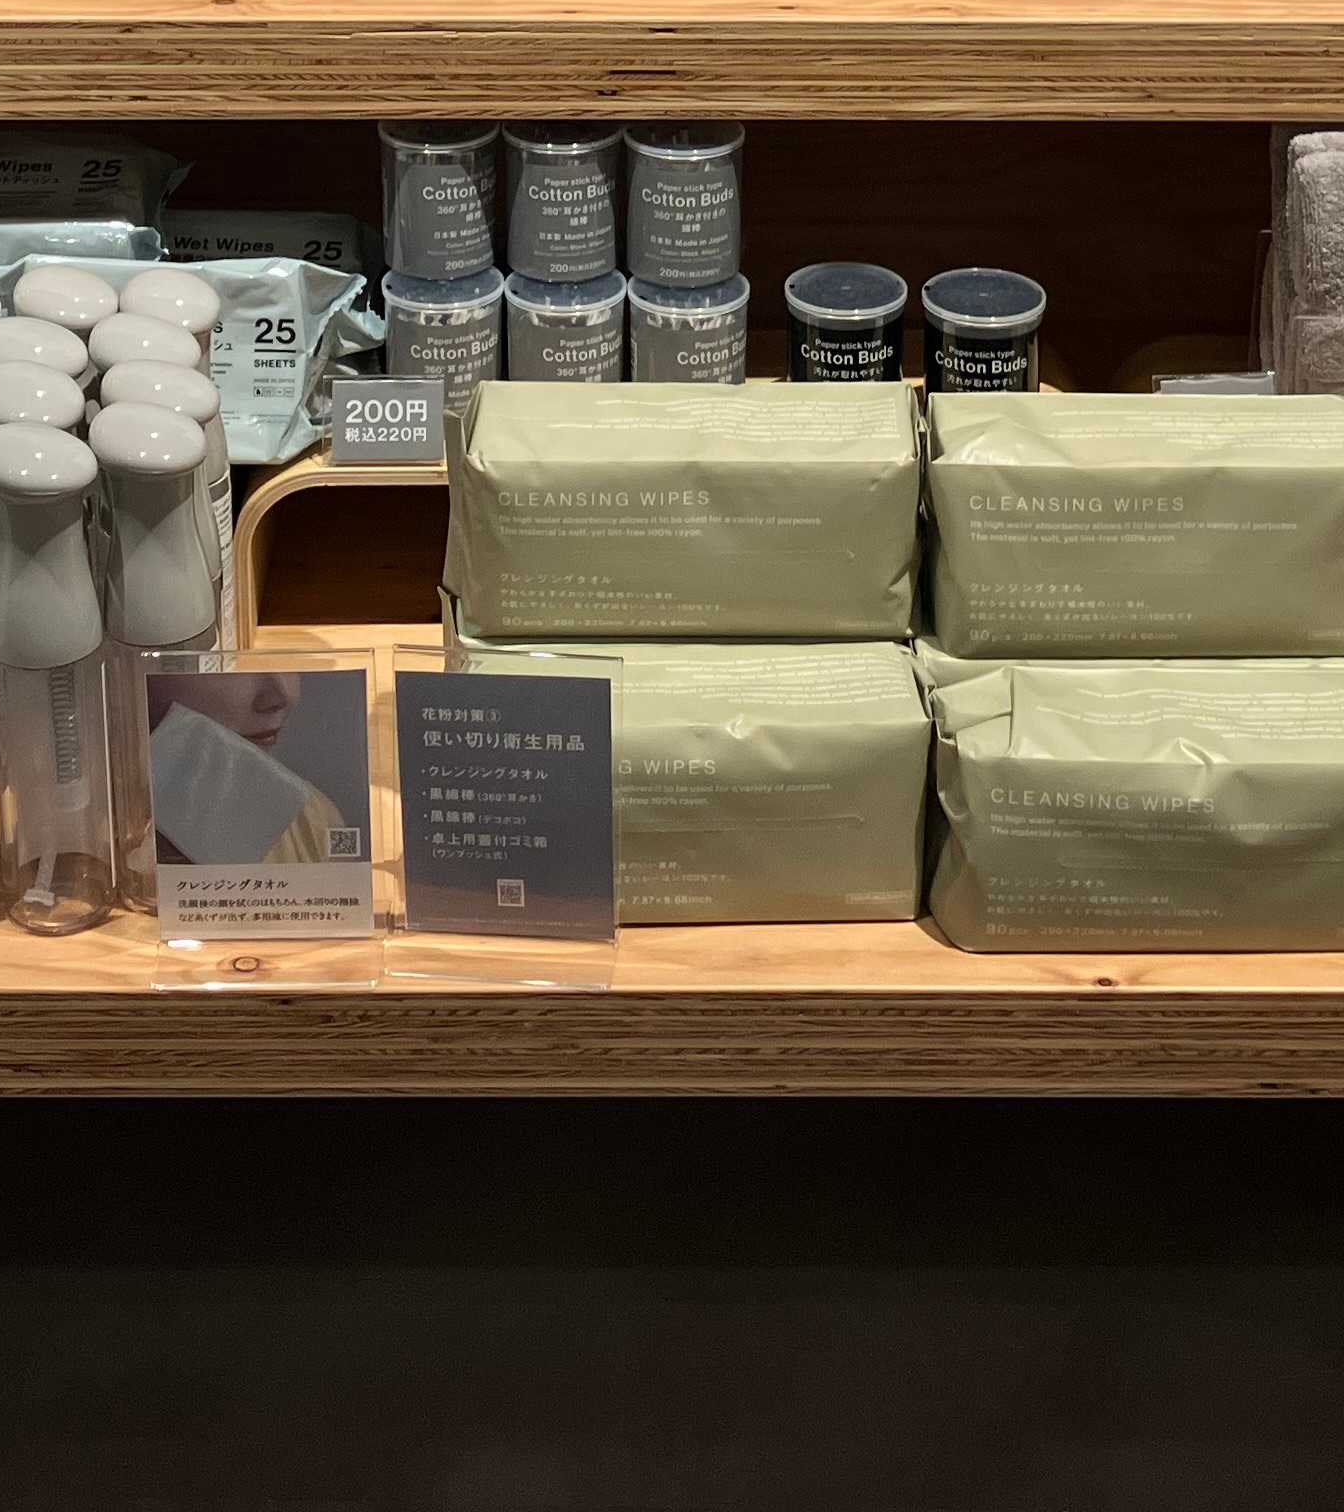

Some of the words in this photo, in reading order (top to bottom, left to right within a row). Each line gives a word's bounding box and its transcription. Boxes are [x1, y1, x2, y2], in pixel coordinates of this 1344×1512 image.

[81, 159, 123, 178] 25
[422, 186, 478, 201] Cotton
[529, 185, 583, 202] Cotton
[642, 189, 697, 208] Cotton
[700, 188, 735, 207] Buds
[174, 236, 209, 250] Wet
[215, 237, 274, 253] Wipes
[304, 240, 344, 261] 25
[255, 318, 296, 345] 25
[410, 344, 467, 361] Cotton
[863, 339, 882, 350] type
[542, 347, 597, 364] Cotton
[677, 349, 729, 366] Cotton
[800, 344, 854, 366] Cotton
[858, 343, 894, 365] Buds
[935, 351, 986, 374] Cotton
[991, 356, 1028, 375] Buds
[254, 359, 296, 368] SHEETS
[345, 400, 428, 424] 200円
[345, 427, 428, 443] 税込220円
[498, 491, 630, 507] CLEANSING
[639, 490, 711, 506] WIPES
[969, 495, 1103, 513] CLEANSING
[1113, 497, 1185, 513] WIPES
[423, 731, 585, 752] 使い切り衛生用品
[643, 759, 717, 775] WIPES
[990, 788, 1130, 811] CLEANSING
[1141, 796, 1216, 813] WIPES
[176, 878, 289, 892] クレンジングタオル
